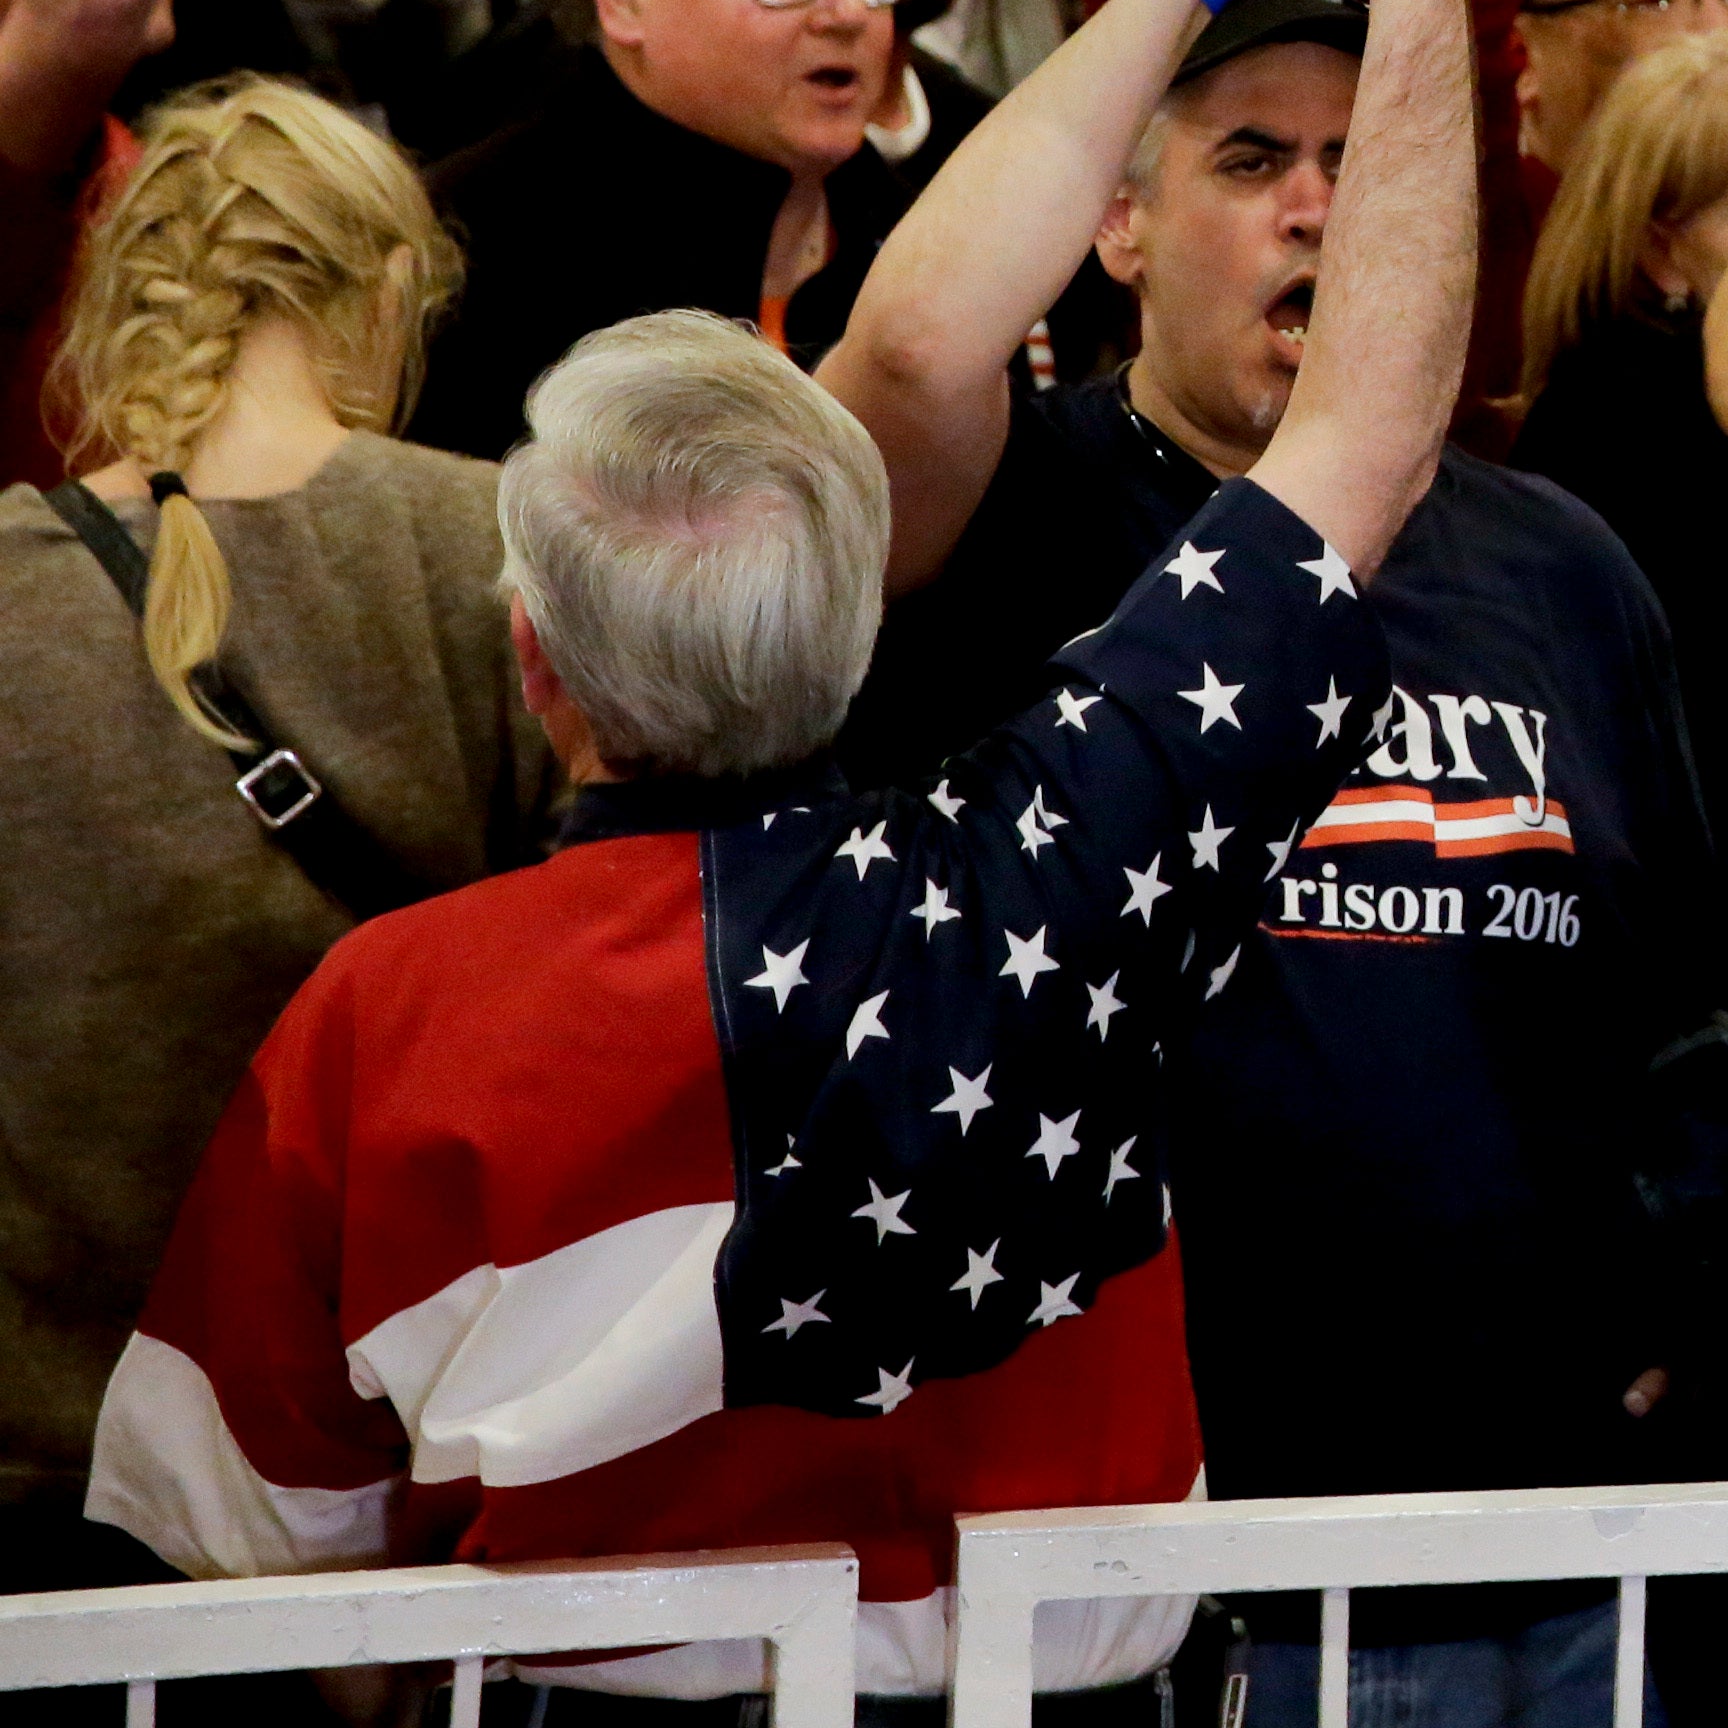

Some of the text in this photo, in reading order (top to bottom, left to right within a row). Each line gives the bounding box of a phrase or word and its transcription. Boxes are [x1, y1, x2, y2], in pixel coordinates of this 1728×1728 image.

[1352, 684, 1548, 827] ary
[1278, 862, 1581, 948] rison 2016
